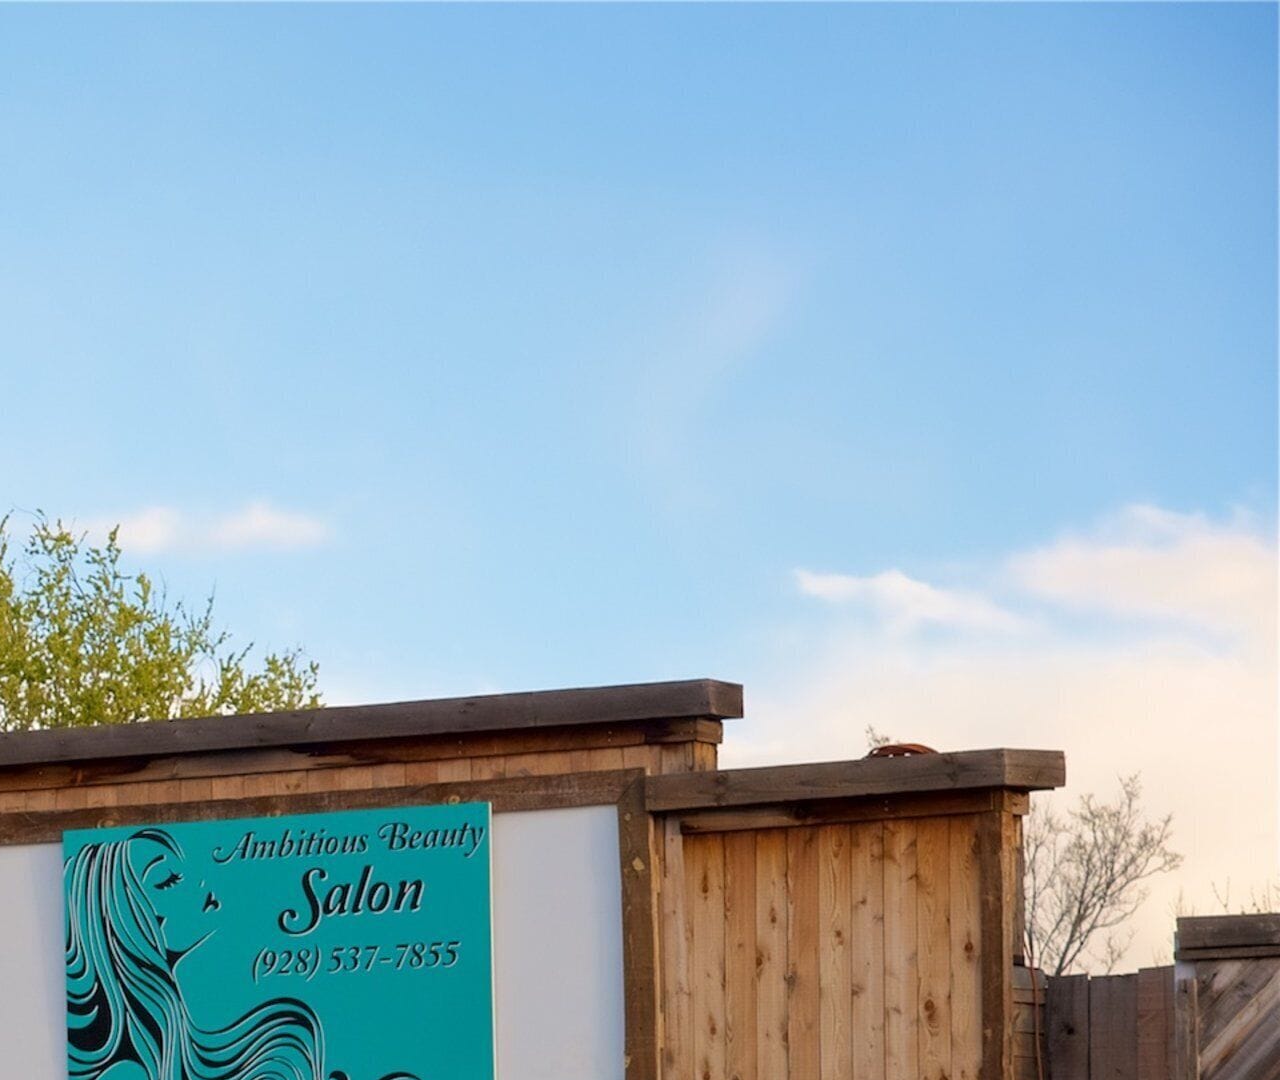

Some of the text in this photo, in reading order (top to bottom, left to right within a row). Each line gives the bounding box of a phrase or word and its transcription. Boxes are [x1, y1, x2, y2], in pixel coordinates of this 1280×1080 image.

[212, 821, 487, 864] Ambitious Beauty
[277, 865, 425, 937] Salon
[251, 940, 462, 984] (928) 537-7855
